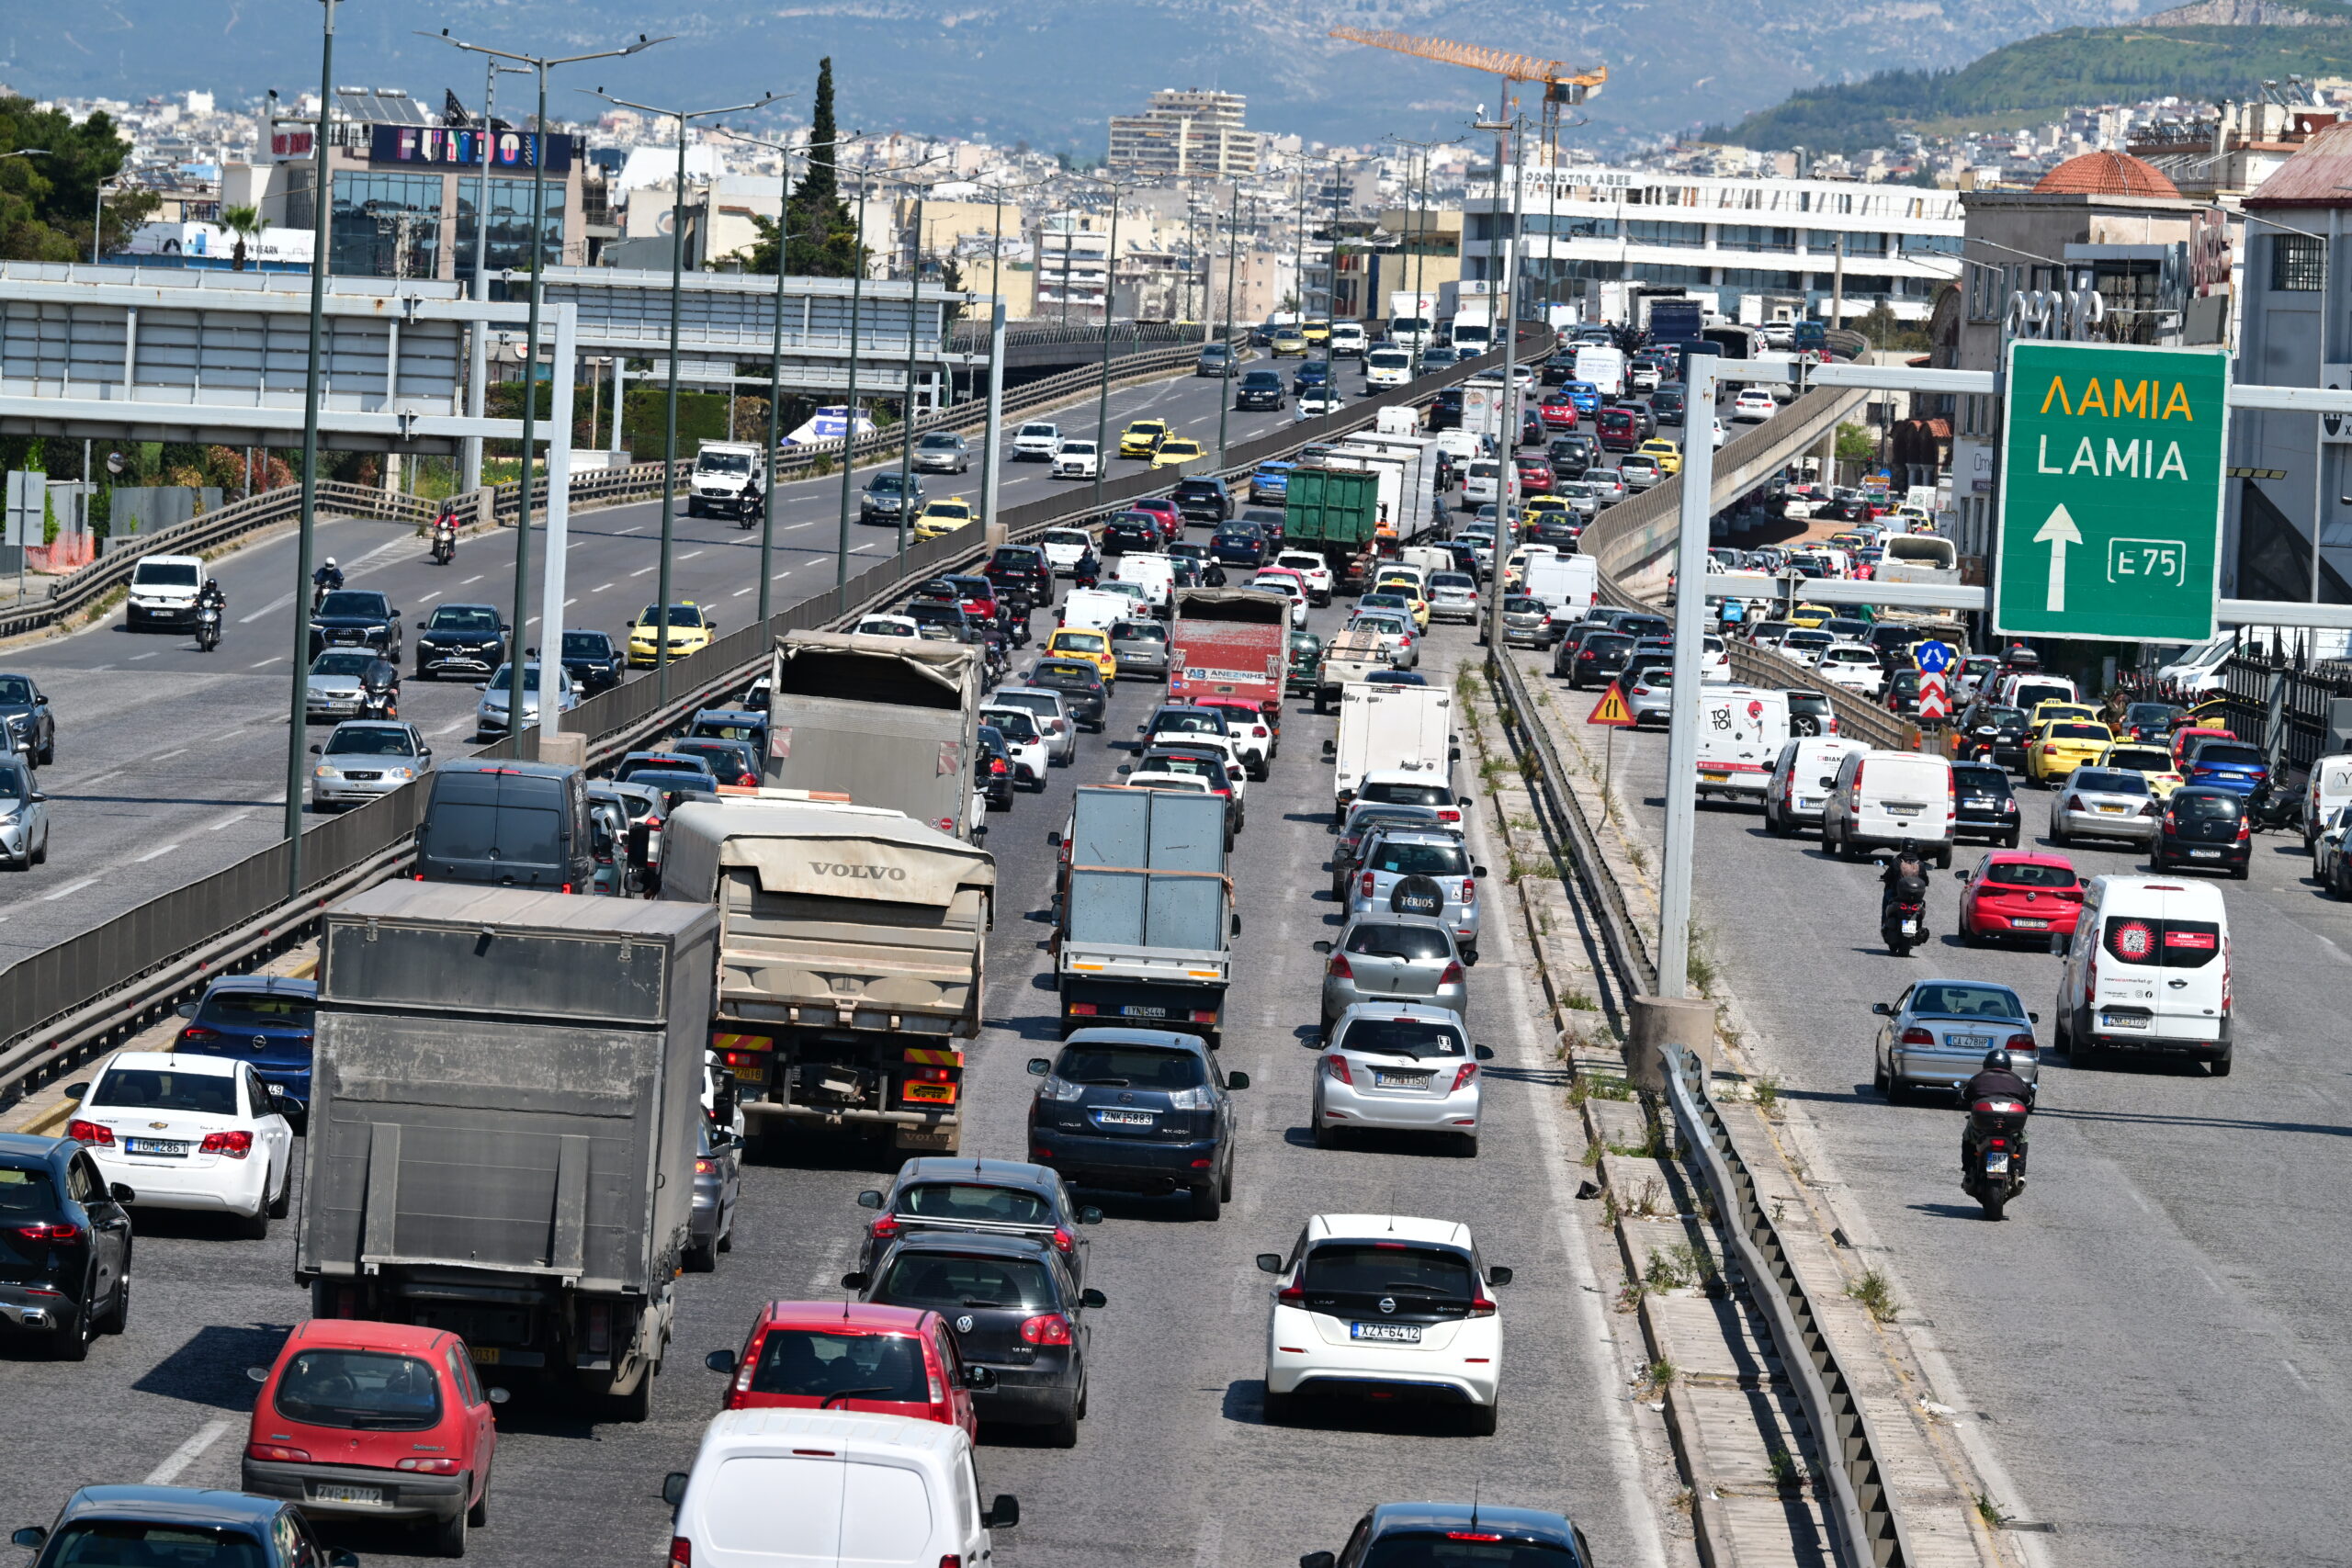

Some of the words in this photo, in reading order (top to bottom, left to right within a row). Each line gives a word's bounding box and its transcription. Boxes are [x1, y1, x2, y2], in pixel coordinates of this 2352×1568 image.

[2040, 375, 2193, 422] ΛΑΜΙΑ
[2038, 434, 2188, 480] LAMIA
[808, 862, 906, 882] VOLVO
[1401, 896, 1434, 908] TERIOS
[1952, 1036, 1962, 1045] CA
